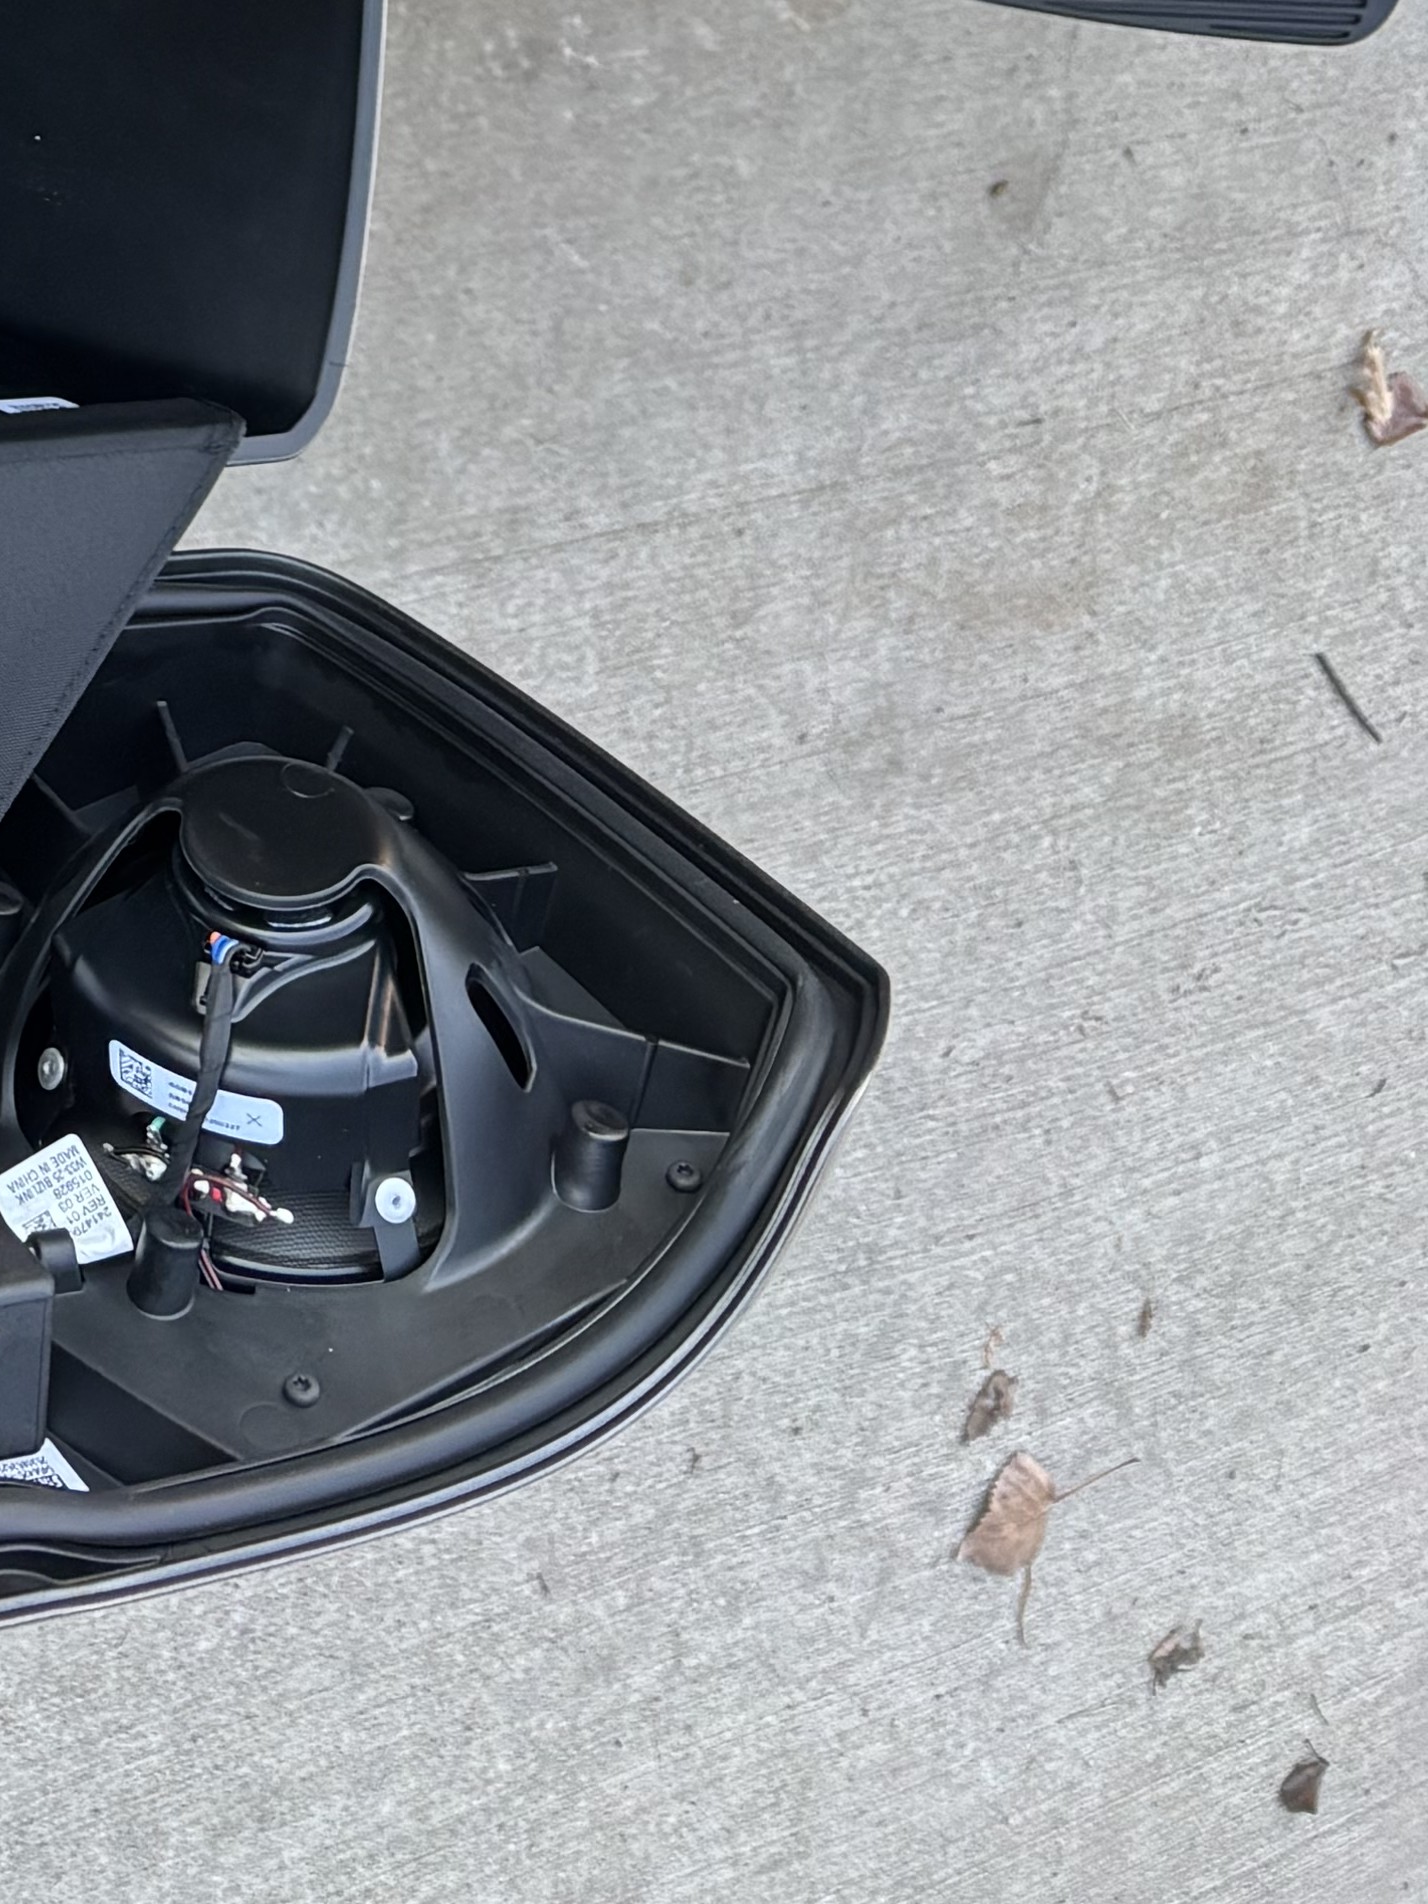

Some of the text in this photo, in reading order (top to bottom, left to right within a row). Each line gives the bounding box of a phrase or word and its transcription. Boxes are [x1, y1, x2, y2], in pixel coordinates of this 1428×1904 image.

[49, 1144, 81, 1168] MADE
[7, 1169, 40, 1194] CHINA
[76, 1182, 101, 1201] VER
[66, 1193, 107, 1224] REV 01
